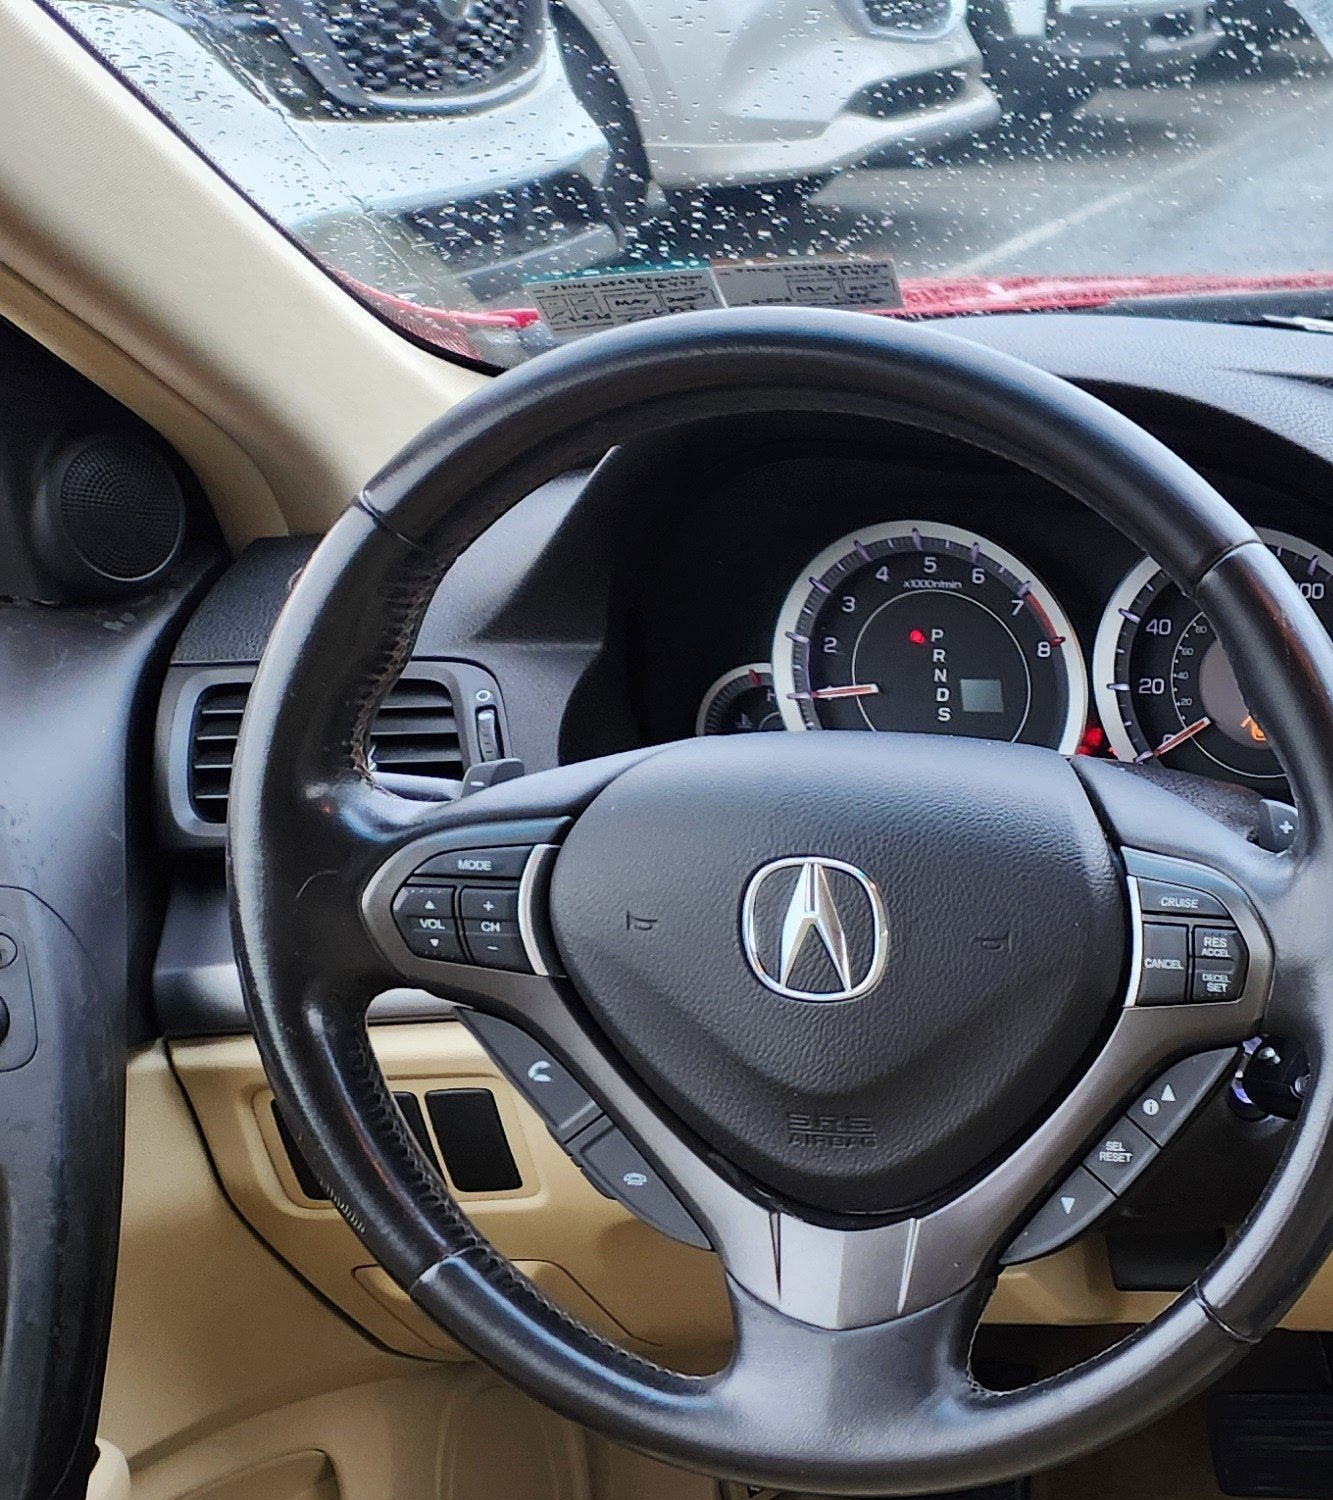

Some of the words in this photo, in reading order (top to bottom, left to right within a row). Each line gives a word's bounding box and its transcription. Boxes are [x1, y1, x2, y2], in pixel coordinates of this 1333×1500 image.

[923, 557, 937, 573] 5
[875, 566, 890, 583] 4
[971, 567, 985, 585] 6
[1297, 583, 1325, 600] 00
[841, 596, 856, 613] 3
[1010, 599, 1025, 616] 7
[1145, 619, 1172, 635] 40
[931, 629, 944, 643] P
[823, 637, 838, 653] 2
[1036, 642, 1051, 658] 8
[932, 649, 946, 663] R
[934, 668, 947, 683] N
[1177, 670, 1189, 680] 40
[1138, 678, 1165, 694] 20
[936, 687, 950, 702] D
[1180, 697, 1192, 706] 20
[937, 707, 951, 722] S
[457, 860, 492, 871] MODE
[1160, 897, 1199, 909] CRUISE
[419, 918, 446, 930] VOL
[481, 921, 501, 932] CH
[1204, 937, 1227, 948] RES
[1201, 948, 1231, 957] ACCEL
[1144, 958, 1184, 970] CANCEL
[1202, 973, 1231, 983] DECEL
[1206, 982, 1228, 993] SET
[1105, 1141, 1126, 1152] SEL
[1099, 1151, 1133, 1163] RESET
